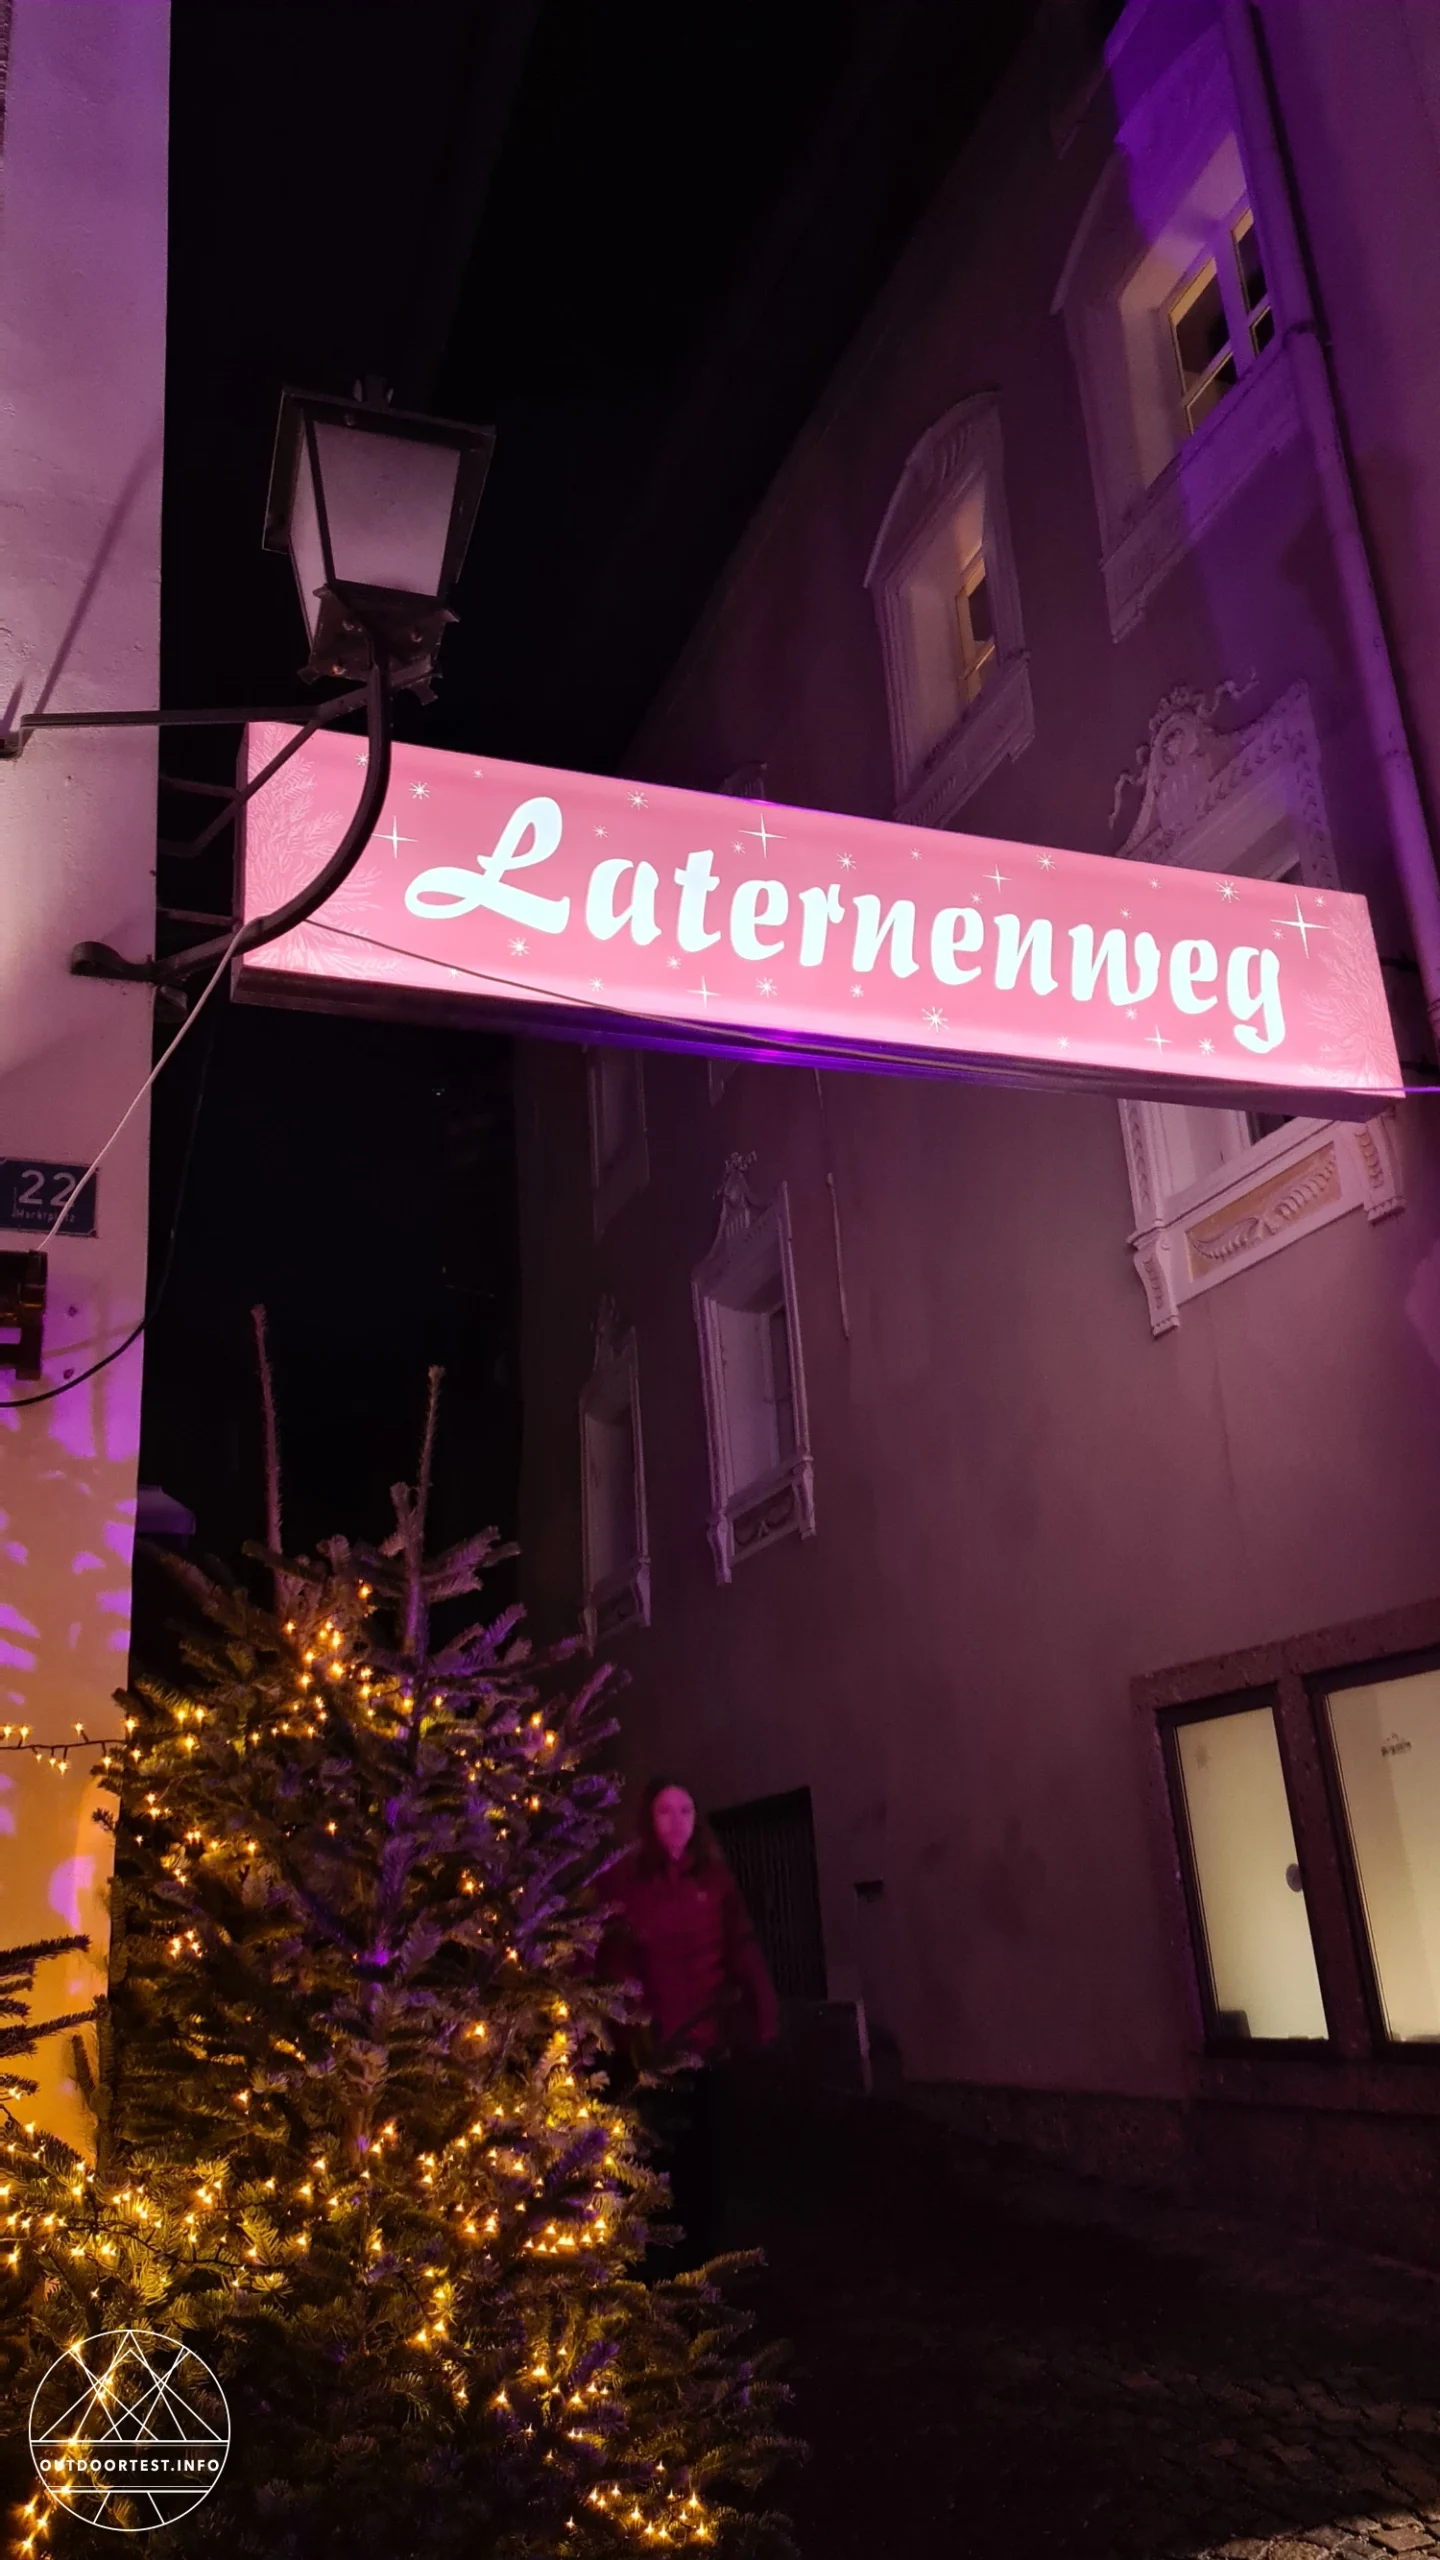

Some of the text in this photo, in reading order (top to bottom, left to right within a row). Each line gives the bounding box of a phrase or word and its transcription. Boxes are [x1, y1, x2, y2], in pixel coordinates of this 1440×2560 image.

[405, 796, 1287, 1054] Laternenweg
[18, 1169, 76, 1207] 22
[15, 1208, 76, 1223] Marktpltz
